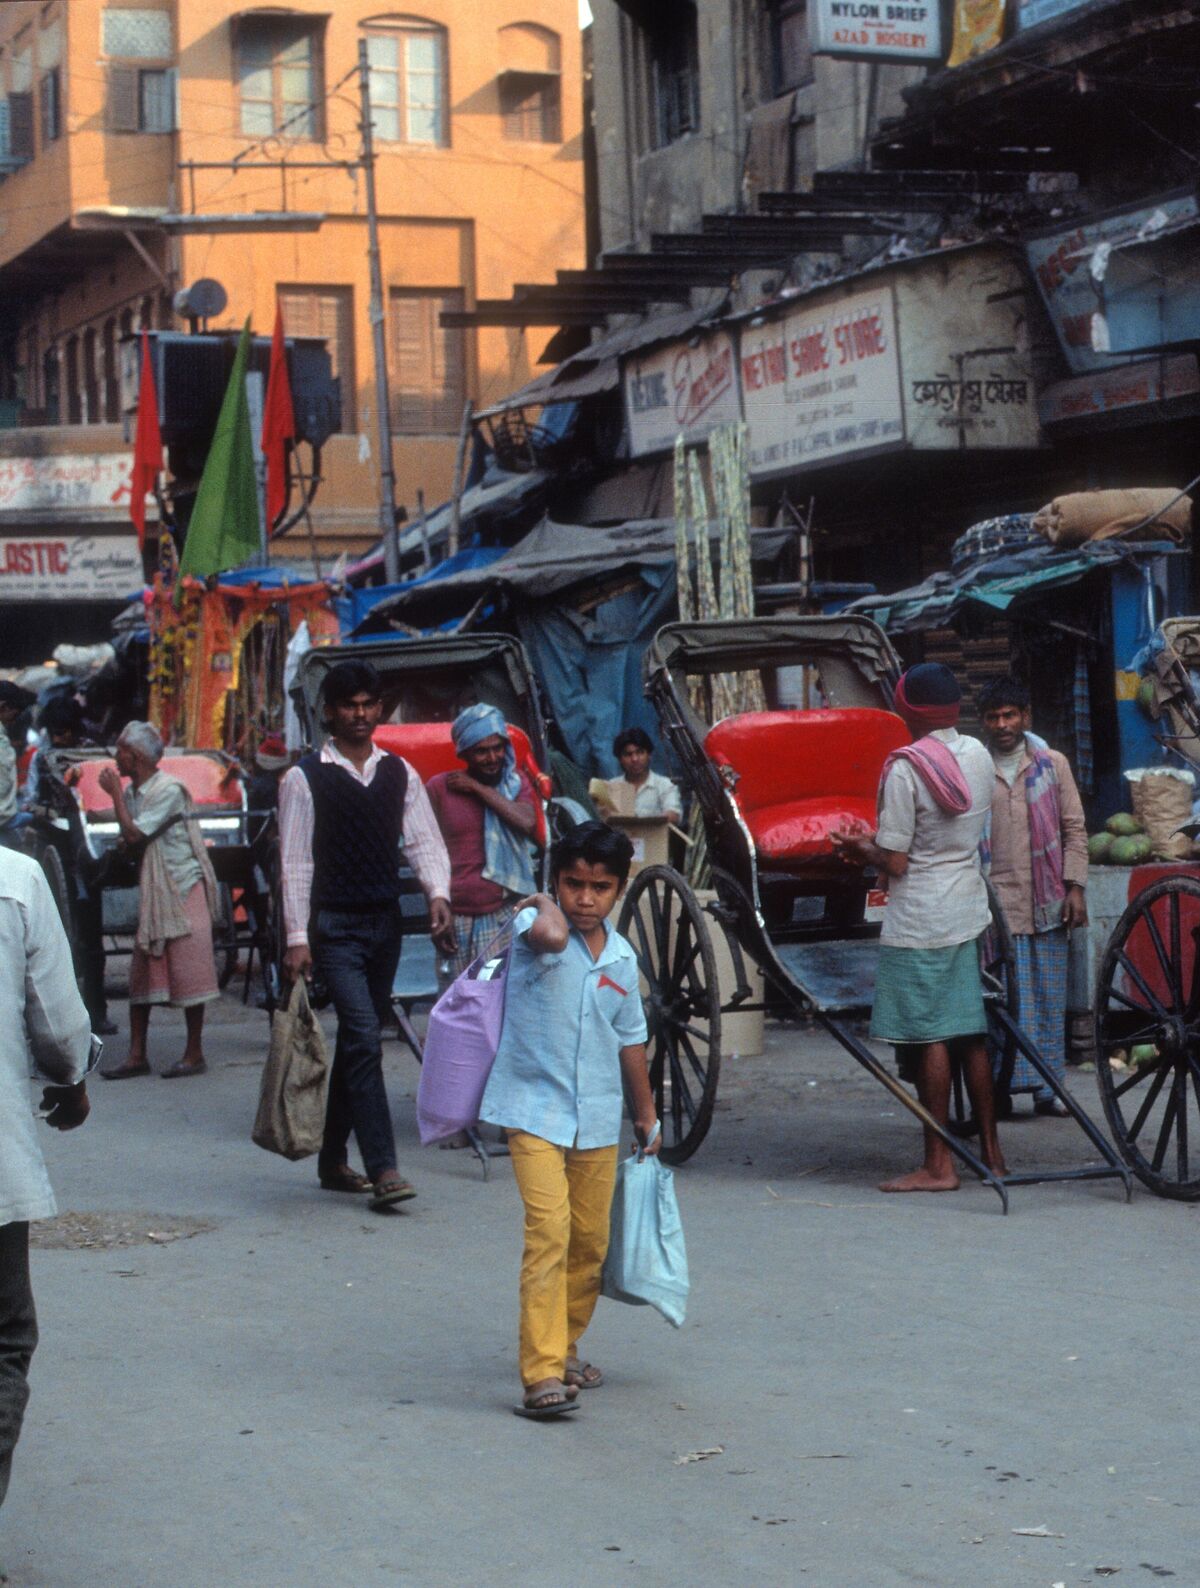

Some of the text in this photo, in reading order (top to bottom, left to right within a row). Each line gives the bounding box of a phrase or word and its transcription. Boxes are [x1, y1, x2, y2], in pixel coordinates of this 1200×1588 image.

[831, 4, 927, 22] NYLON BRIEF
[832, 30, 869, 45] AZAD
[833, 316, 886, 365] STORE
[0, 543, 69, 575] ASTIC
